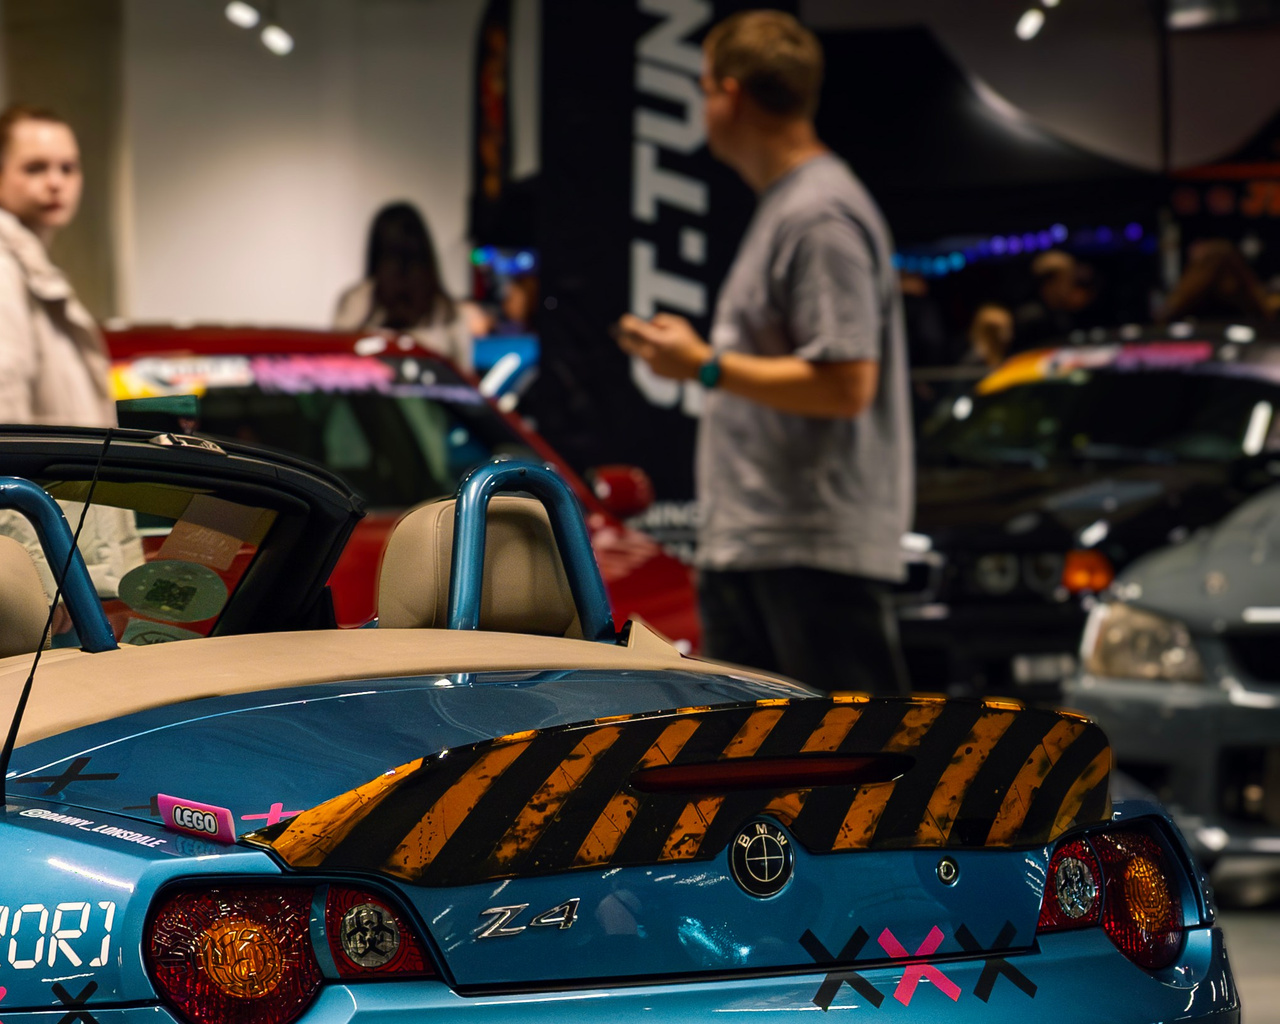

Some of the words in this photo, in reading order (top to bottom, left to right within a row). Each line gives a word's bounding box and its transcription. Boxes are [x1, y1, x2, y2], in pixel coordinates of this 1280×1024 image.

[174, 806, 218, 833] LEGO
[738, 823, 787, 848] BMW
[477, 897, 581, 940] Z4
